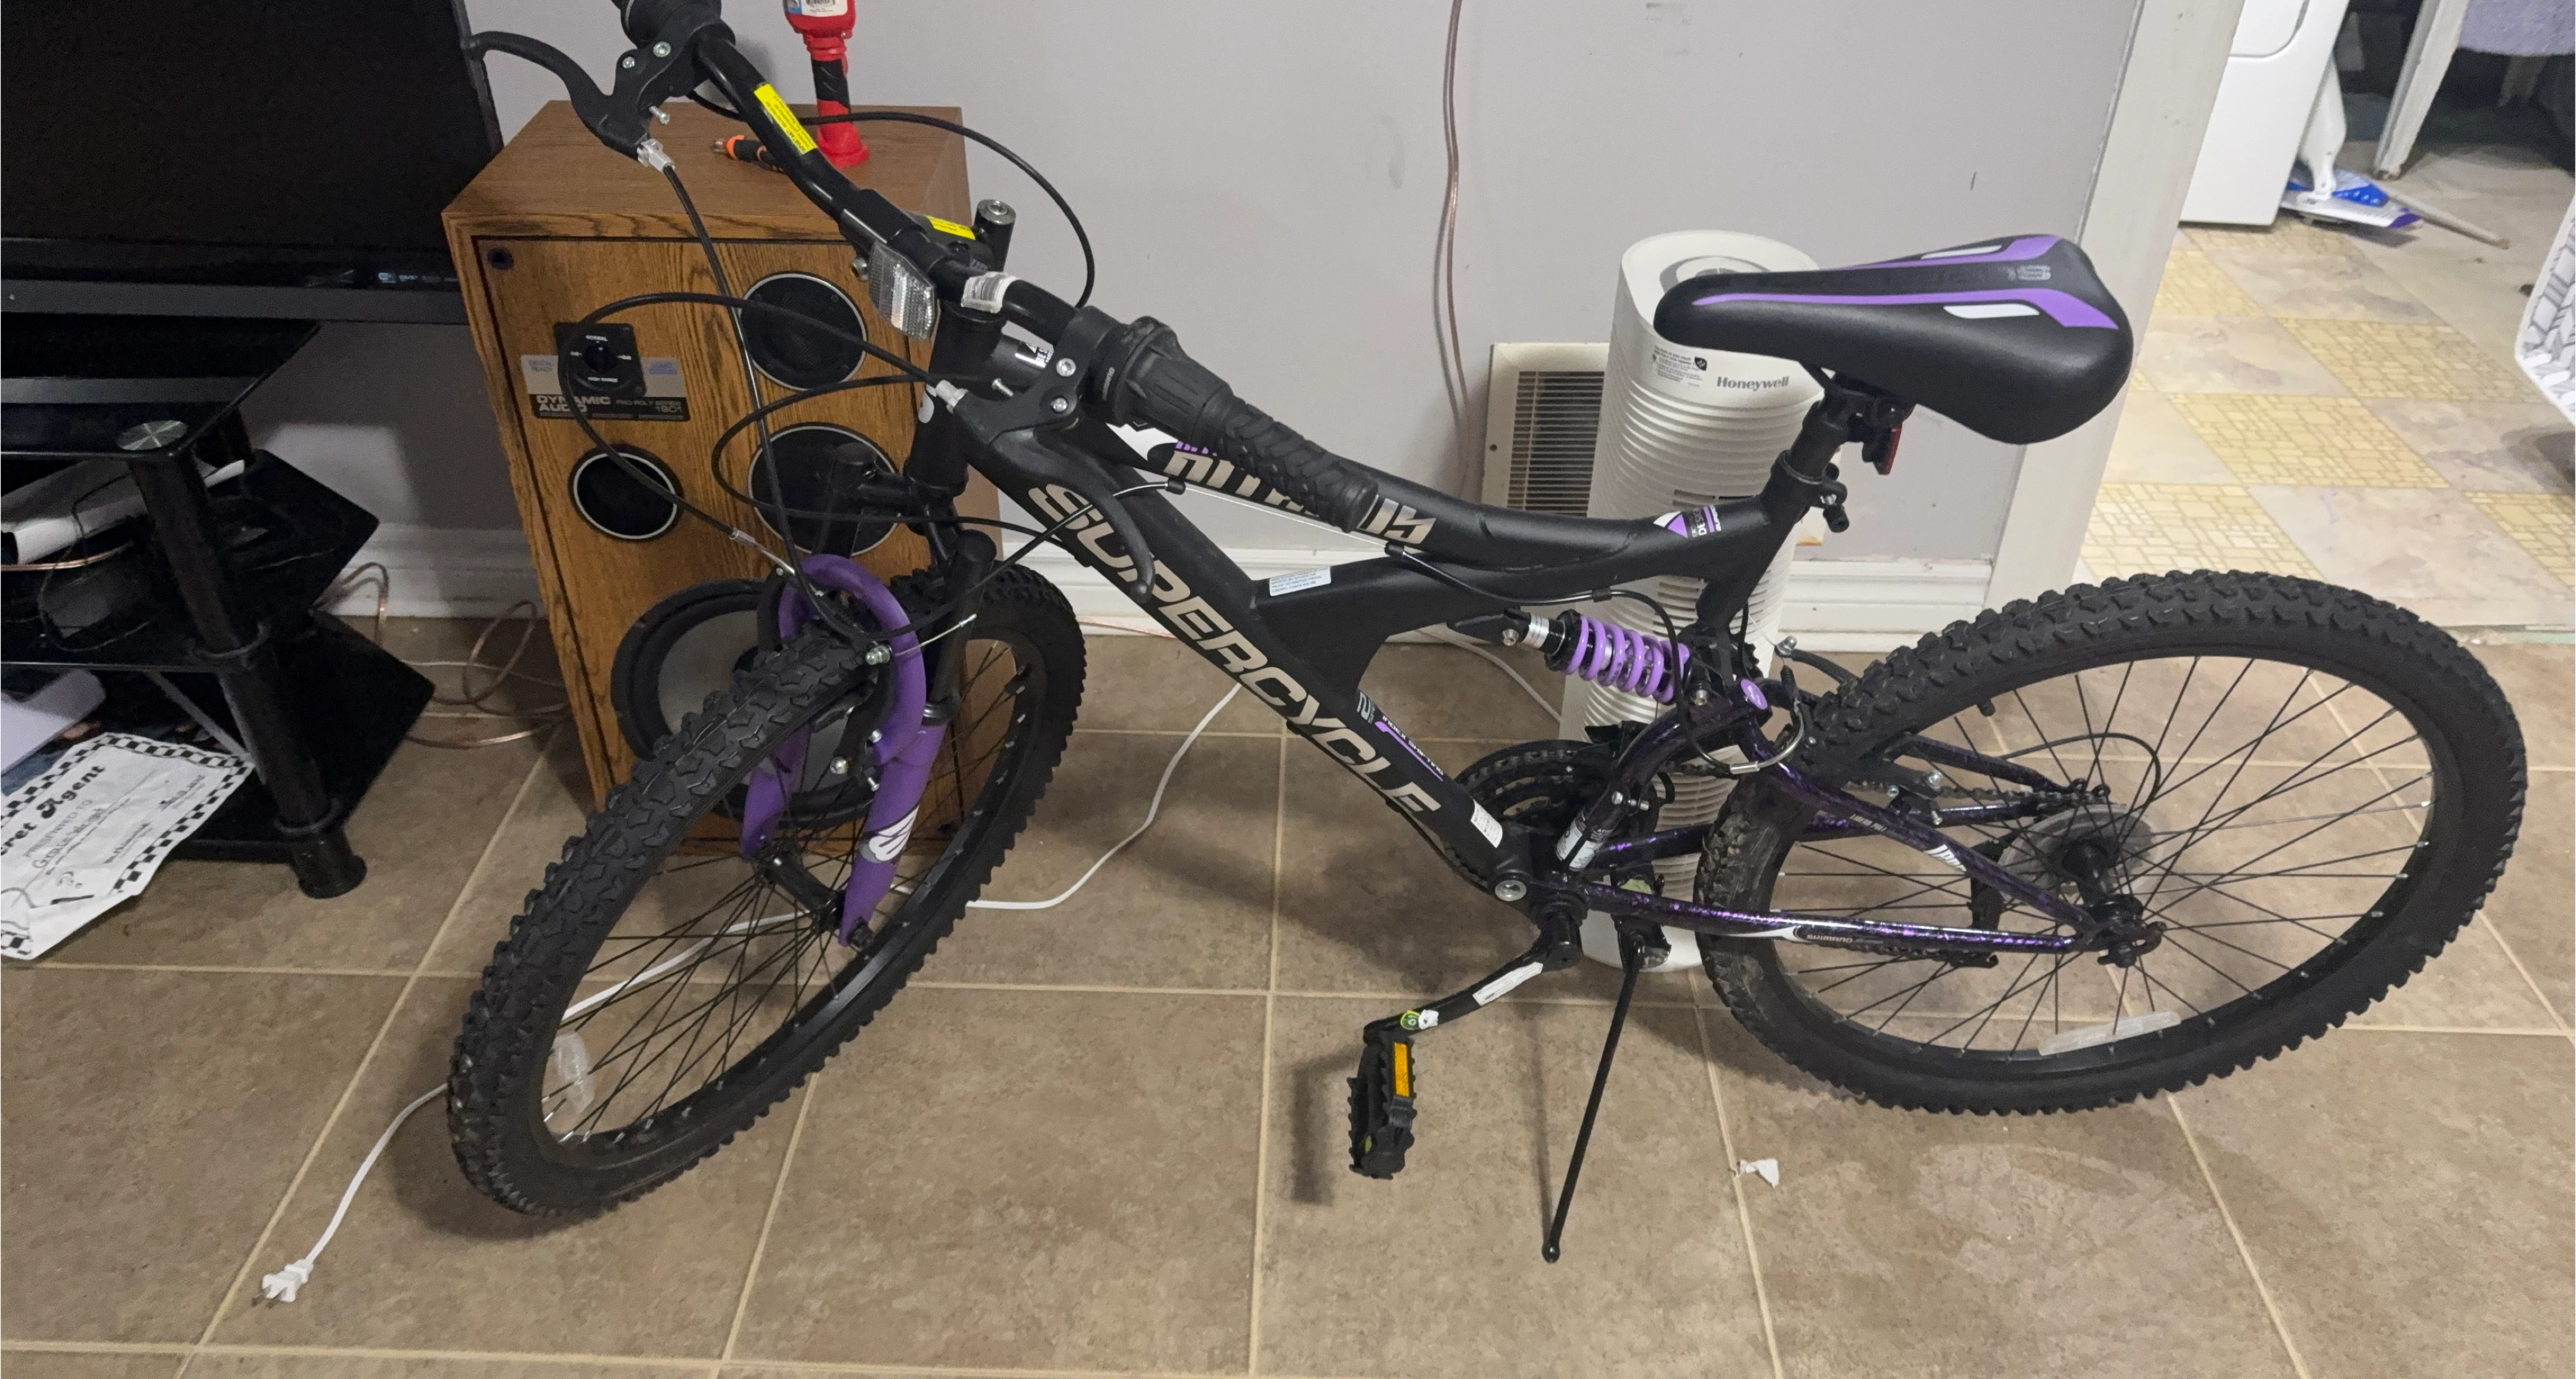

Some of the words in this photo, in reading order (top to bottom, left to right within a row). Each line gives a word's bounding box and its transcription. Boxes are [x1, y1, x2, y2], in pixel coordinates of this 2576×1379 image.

[1717, 376, 1789, 392] Honeywell
[1382, 715, 1406, 740] INDEX
[1408, 740, 1444, 776] SHIFTING
[36, 766, 105, 819] Agent
[1806, 933, 1853, 944] SHIMANO
